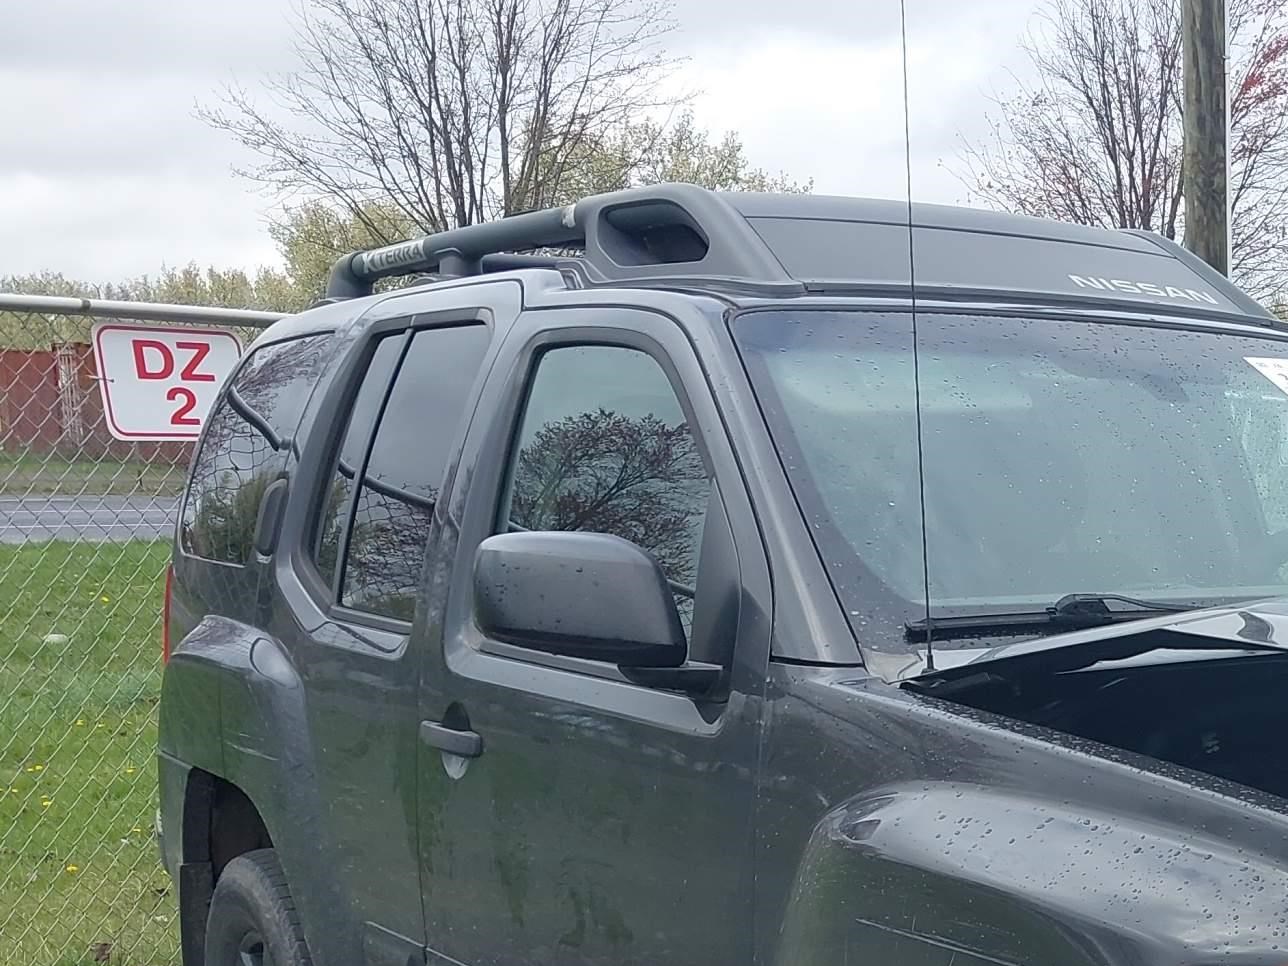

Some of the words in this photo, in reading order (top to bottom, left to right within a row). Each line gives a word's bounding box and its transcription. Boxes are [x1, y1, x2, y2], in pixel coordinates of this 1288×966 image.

[1067, 274, 1219, 305] NISSAN
[131, 339, 216, 382] DZ
[166, 387, 201, 425] 2
